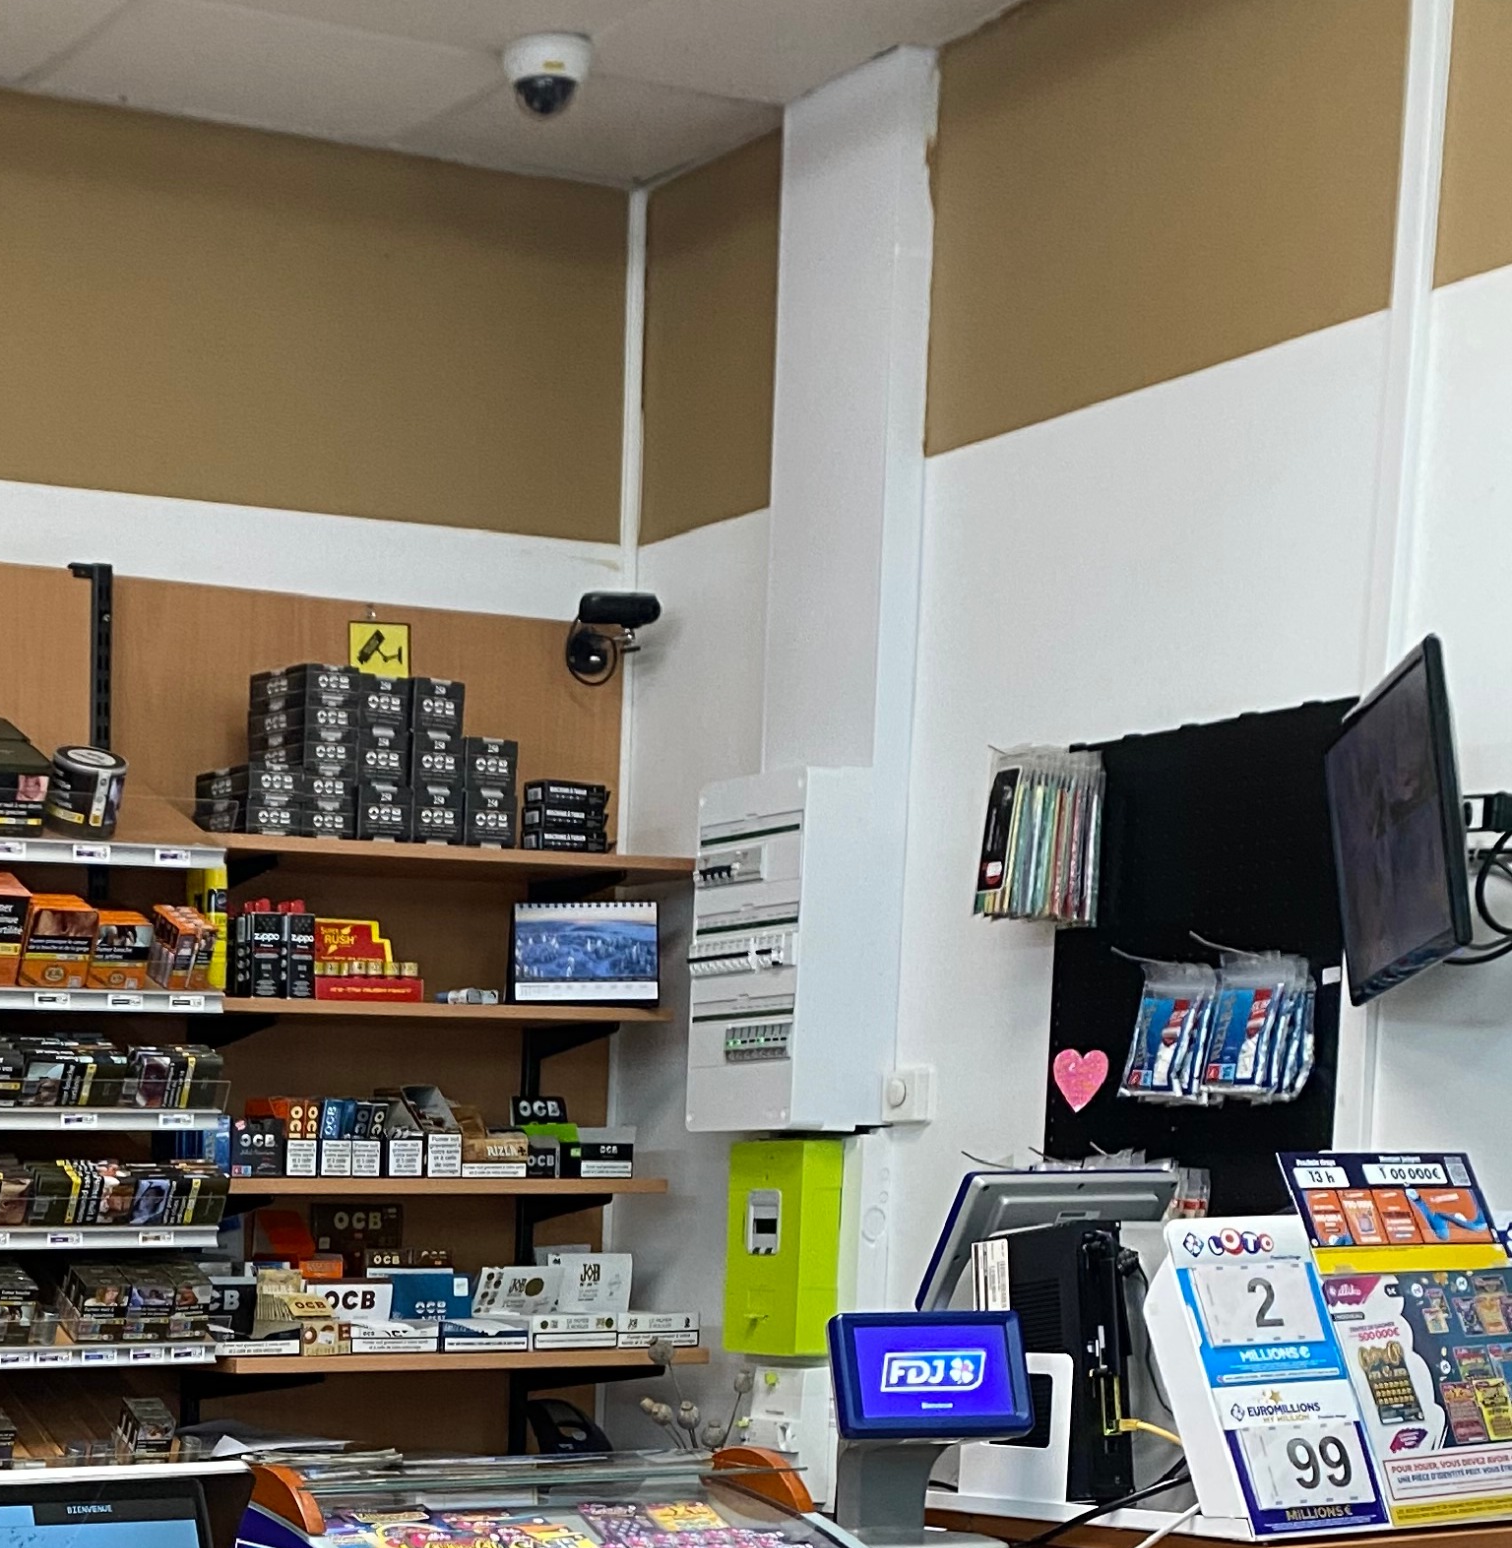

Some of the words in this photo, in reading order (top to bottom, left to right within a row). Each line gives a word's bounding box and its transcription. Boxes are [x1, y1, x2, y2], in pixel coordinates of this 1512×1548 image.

[324, 935, 355, 944] RUSH
[519, 1100, 560, 1117] OCB
[240, 1134, 276, 1147] OCB
[600, 1146, 618, 1154] OCB
[527, 1155, 555, 1167] OCB
[334, 1212, 382, 1230] OCB
[1208, 1228, 1274, 1256] LOTO
[374, 1255, 400, 1265] OCB
[294, 1301, 326, 1309] OCB
[324, 1290, 376, 1310] OCB
[415, 1301, 447, 1313] OCB
[1248, 1277, 1284, 1327] 2
[1240, 1346, 1299, 1362] MILLIONS
[889, 1360, 946, 1384] FDJ
[1247, 1402, 1321, 1417] EUROMILLIONS
[1287, 1436, 1352, 1490] 99
[1286, 1506, 1343, 1521] MILLIONS
